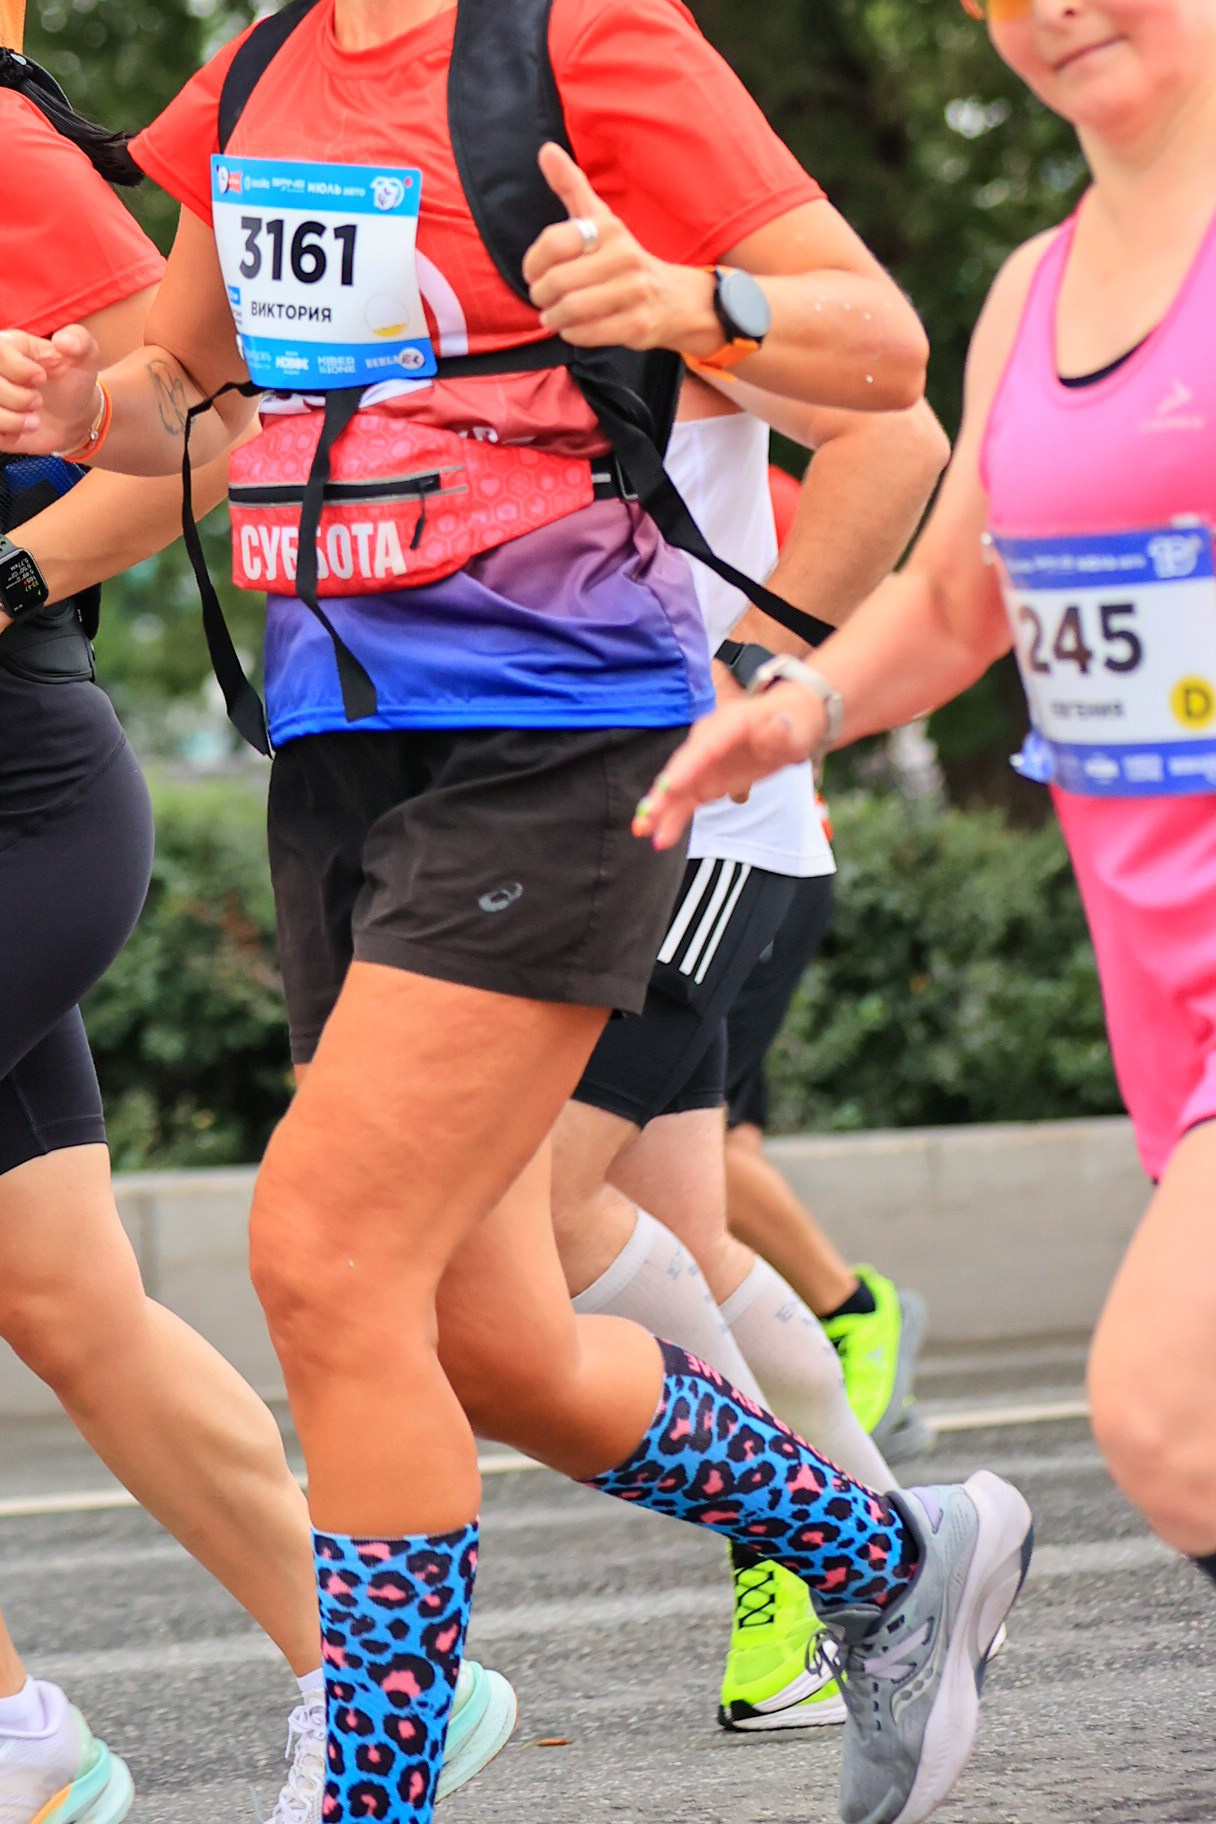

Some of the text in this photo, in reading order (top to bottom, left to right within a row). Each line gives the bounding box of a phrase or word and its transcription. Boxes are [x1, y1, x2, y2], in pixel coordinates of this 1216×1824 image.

[239, 216, 358, 287] 3161
[250, 300, 332, 323] ВИКТОРИЯ
[1183, 687, 1212, 720] D
